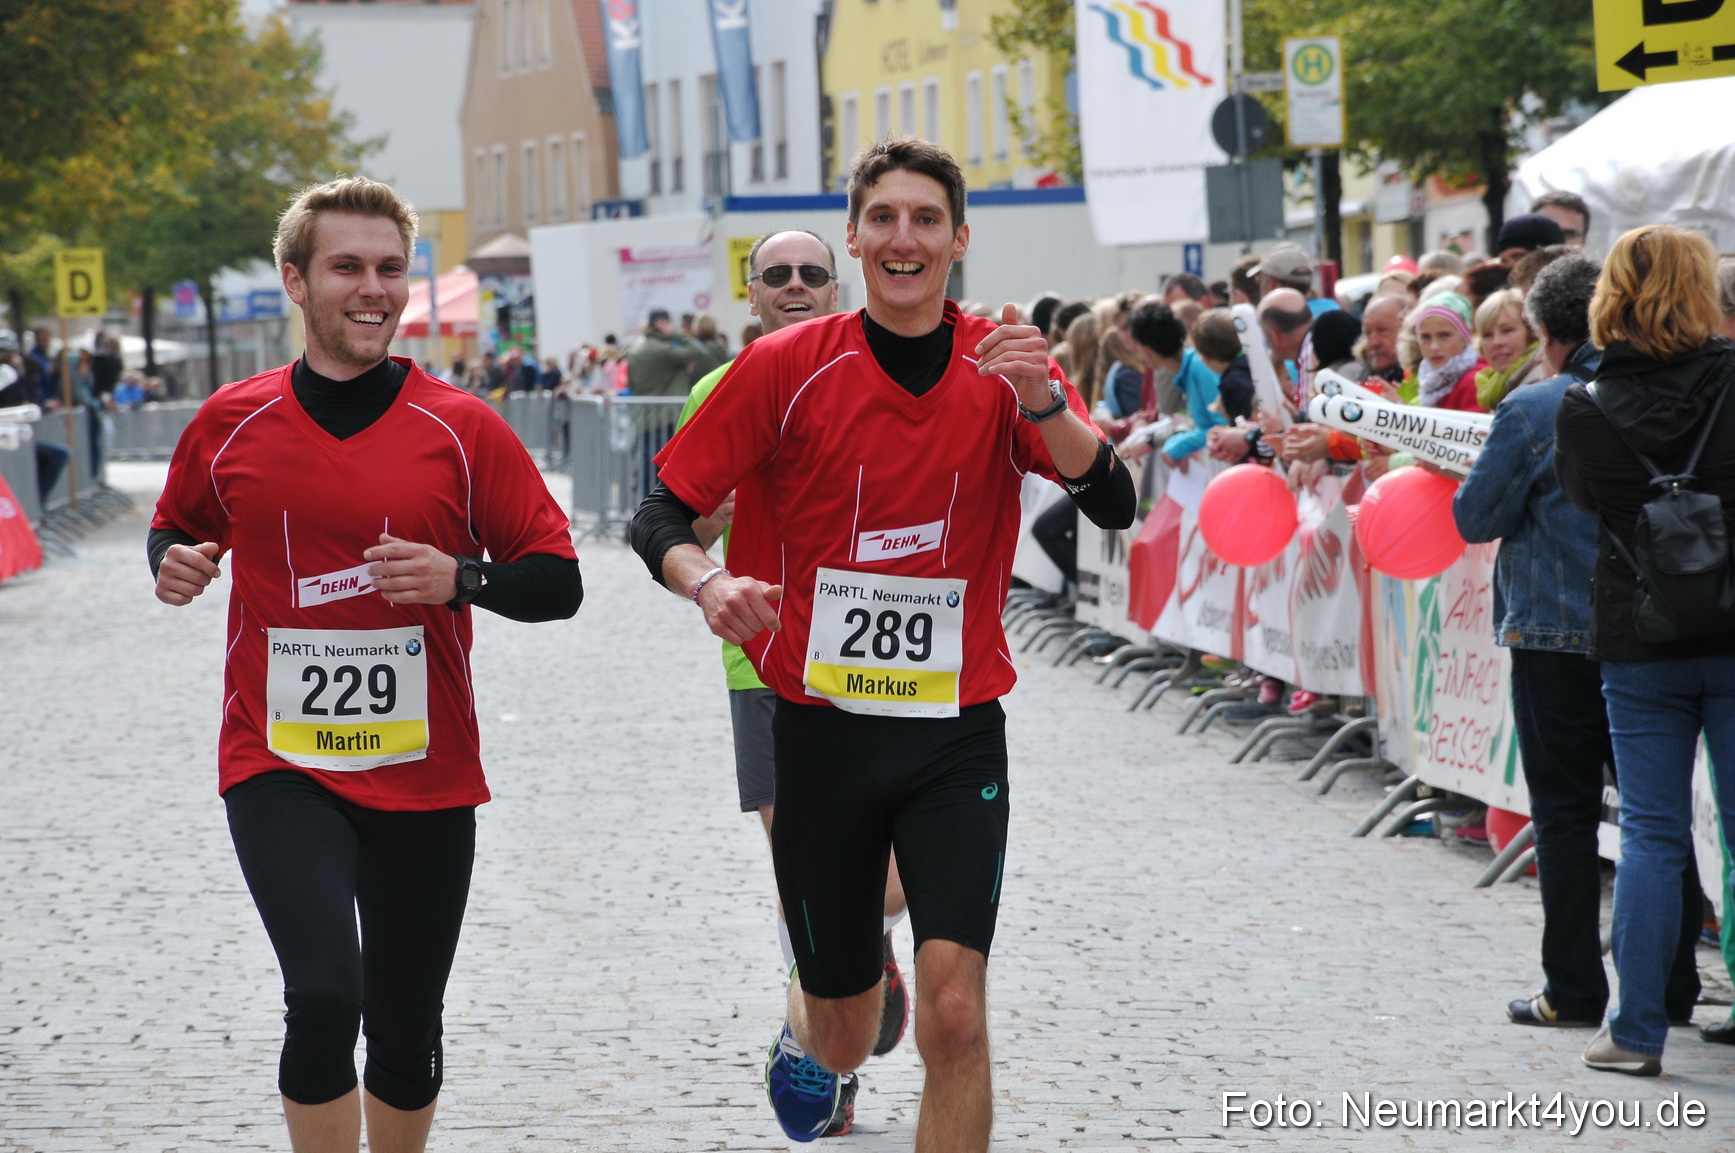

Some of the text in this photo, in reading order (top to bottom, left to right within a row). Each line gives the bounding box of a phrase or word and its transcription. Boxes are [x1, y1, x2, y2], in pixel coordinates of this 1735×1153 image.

[70, 270, 92, 301] D
[1375, 409, 1427, 434] BMW
[881, 534, 921, 551] DEHN
[321, 576, 359, 595] DEHN
[819, 582, 941, 606] PARTL Neumarkt
[840, 608, 933, 662] 289
[272, 642, 399, 657] PARTL Neumarkt
[301, 663, 397, 716] 229
[846, 673, 918, 697] Markus
[316, 730, 381, 750] Martin
